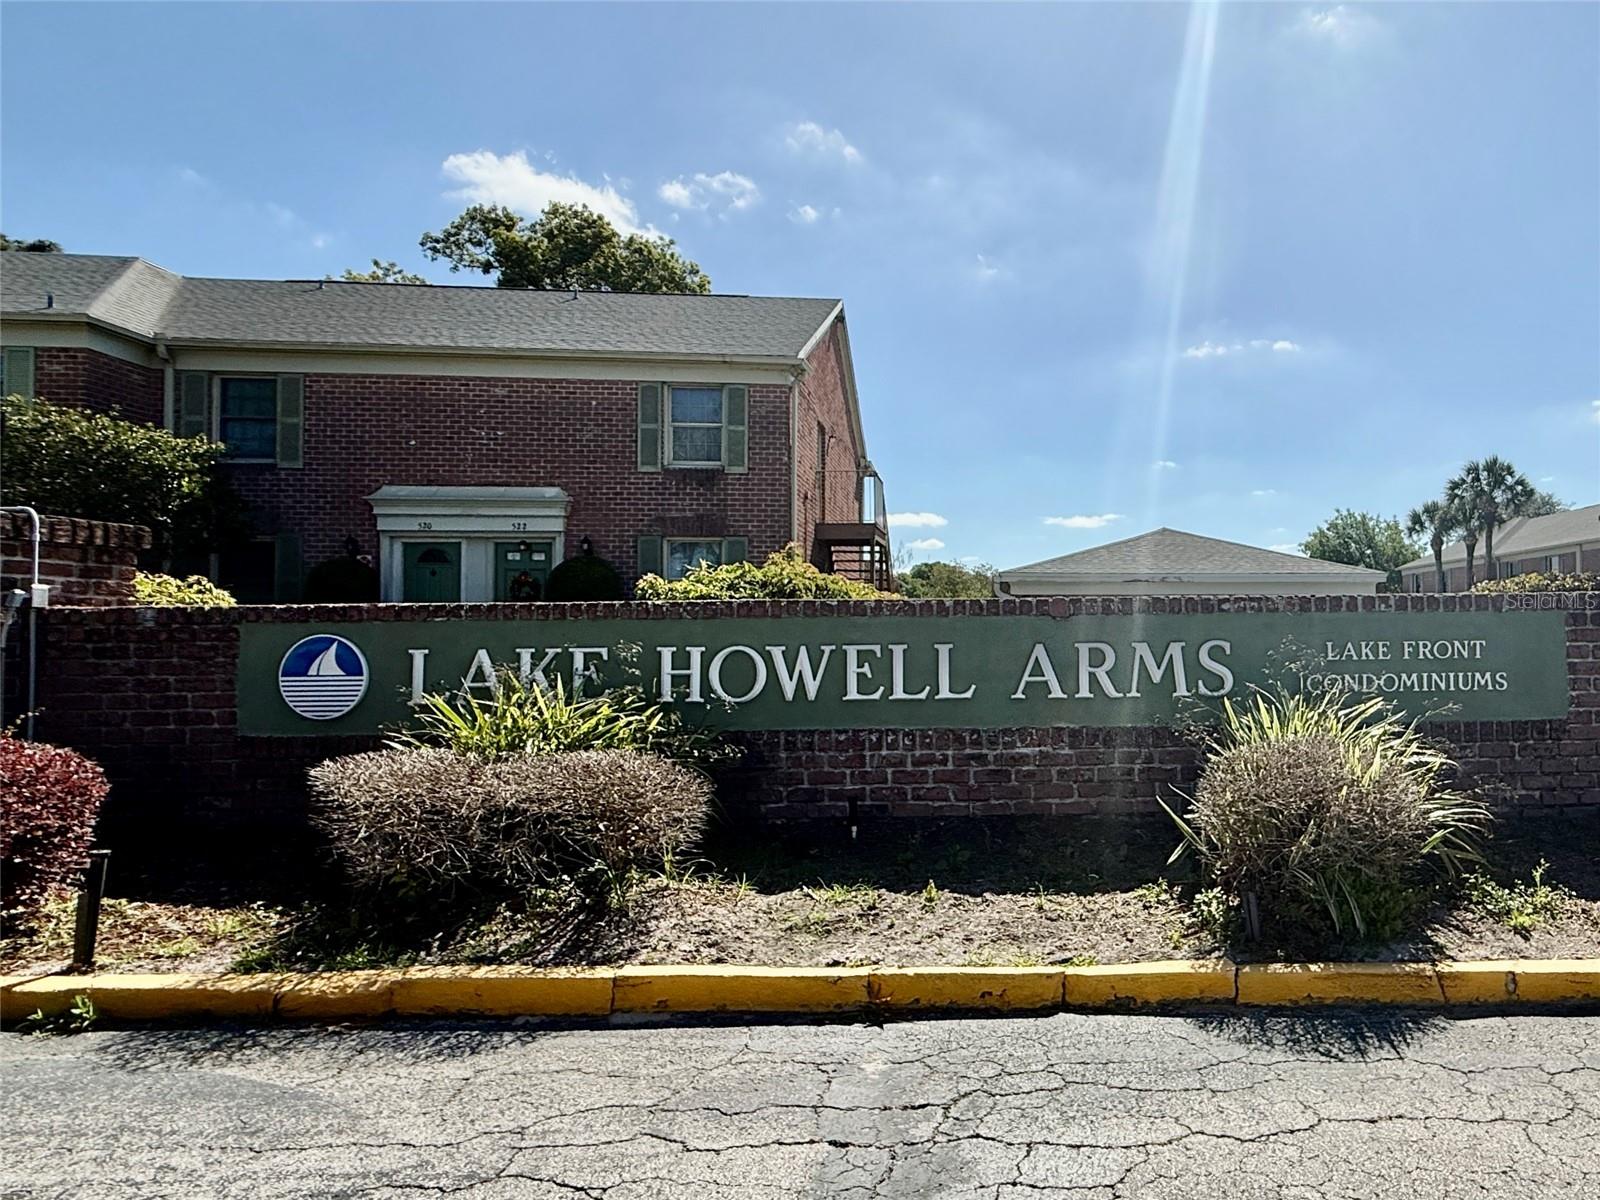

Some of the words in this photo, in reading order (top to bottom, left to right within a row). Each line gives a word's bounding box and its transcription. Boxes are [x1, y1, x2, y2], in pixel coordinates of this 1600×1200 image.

[418, 522, 433, 530] 520
[512, 522, 527, 530] 522
[1326, 641, 1391, 661] LAKE
[1402, 640, 1486, 660] FRONT
[656, 643, 976, 703] HOWELL
[1011, 639, 1234, 699] ARMS
[1306, 672, 1508, 693] CONDOMINIUMS
